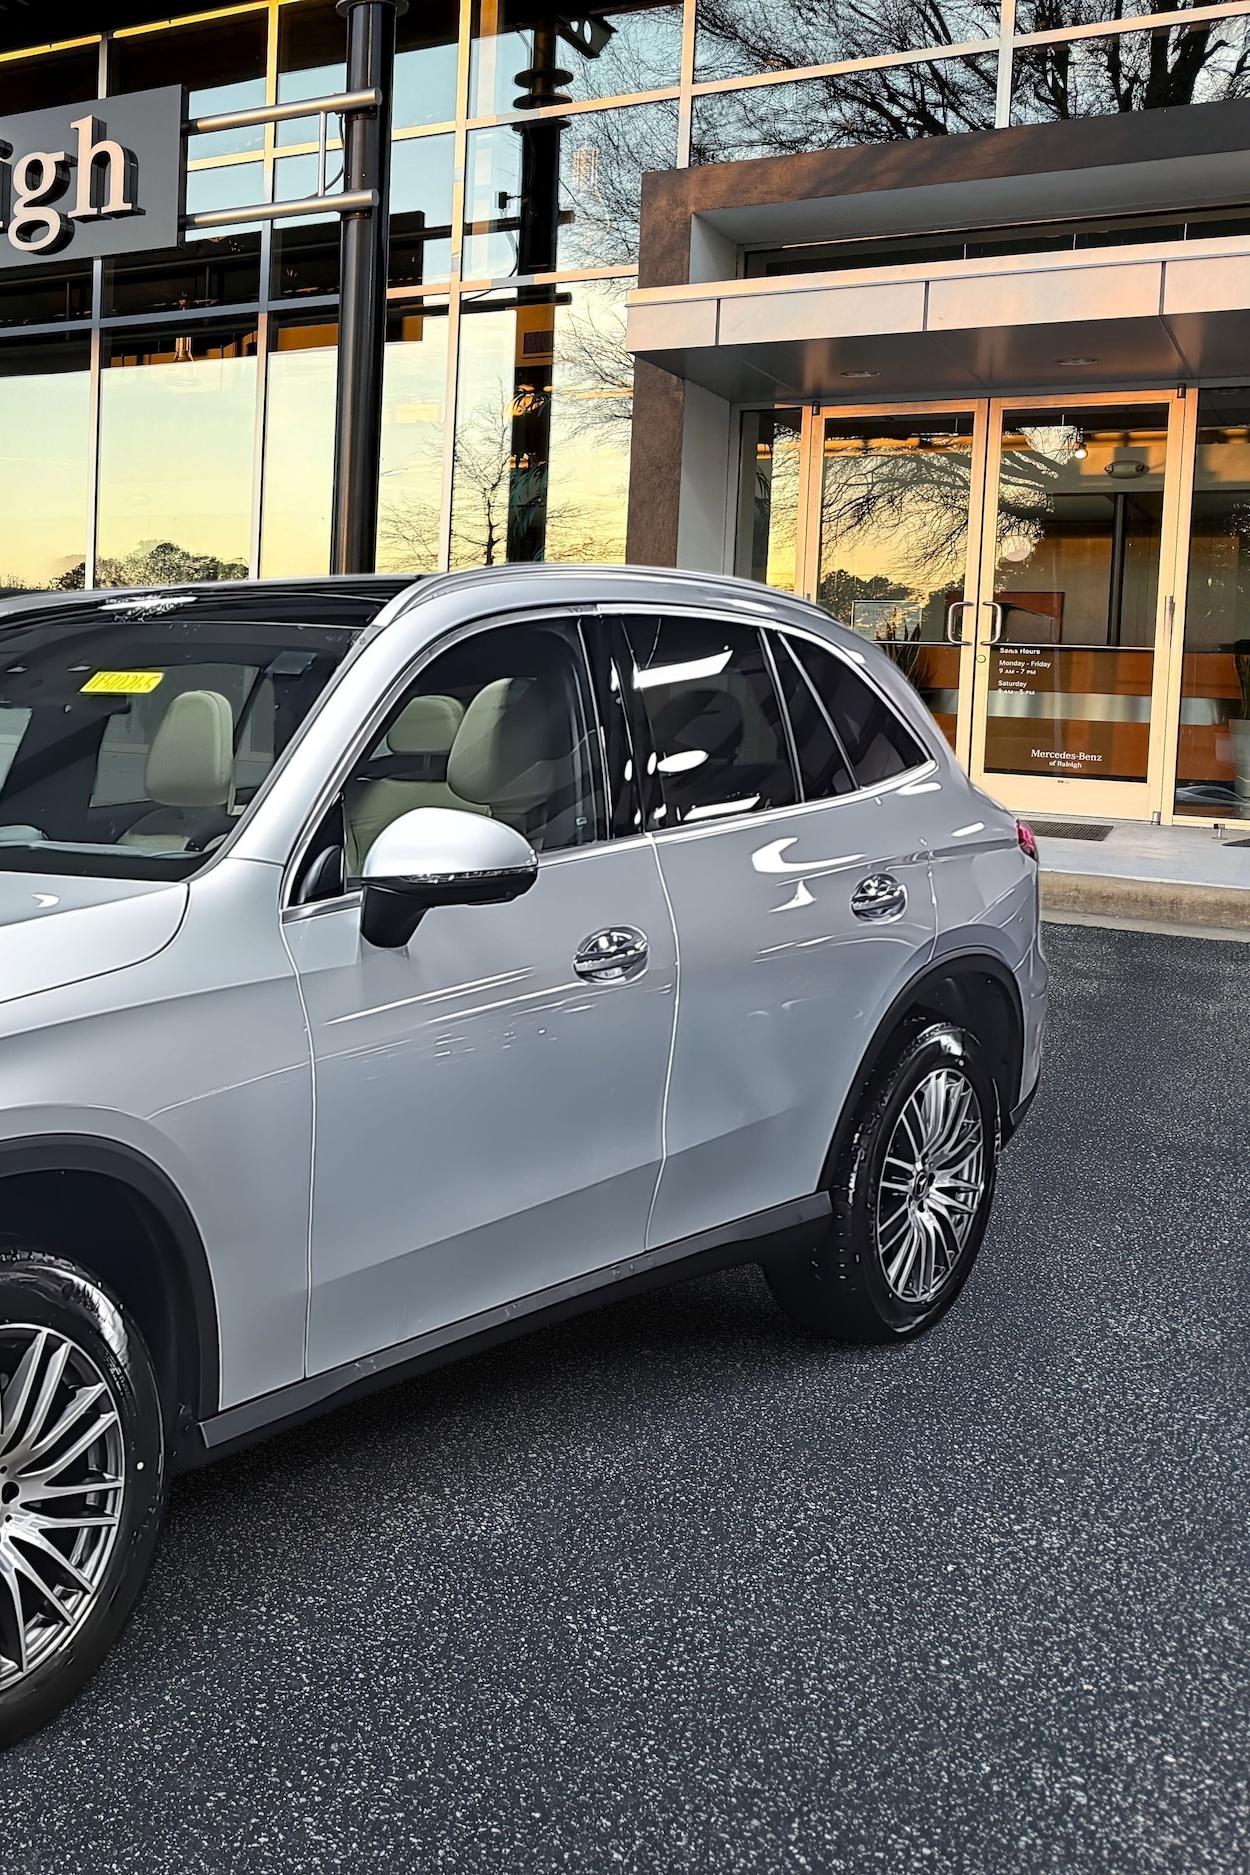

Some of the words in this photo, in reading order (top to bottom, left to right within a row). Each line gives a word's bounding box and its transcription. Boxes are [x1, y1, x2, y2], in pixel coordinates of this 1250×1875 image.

[998, 660, 1025, 668] Monday
[1030, 660, 1051, 669] Friday
[998, 680, 1027, 688] Saturday
[1031, 749, 1103, 762] Mercedes-Benz
